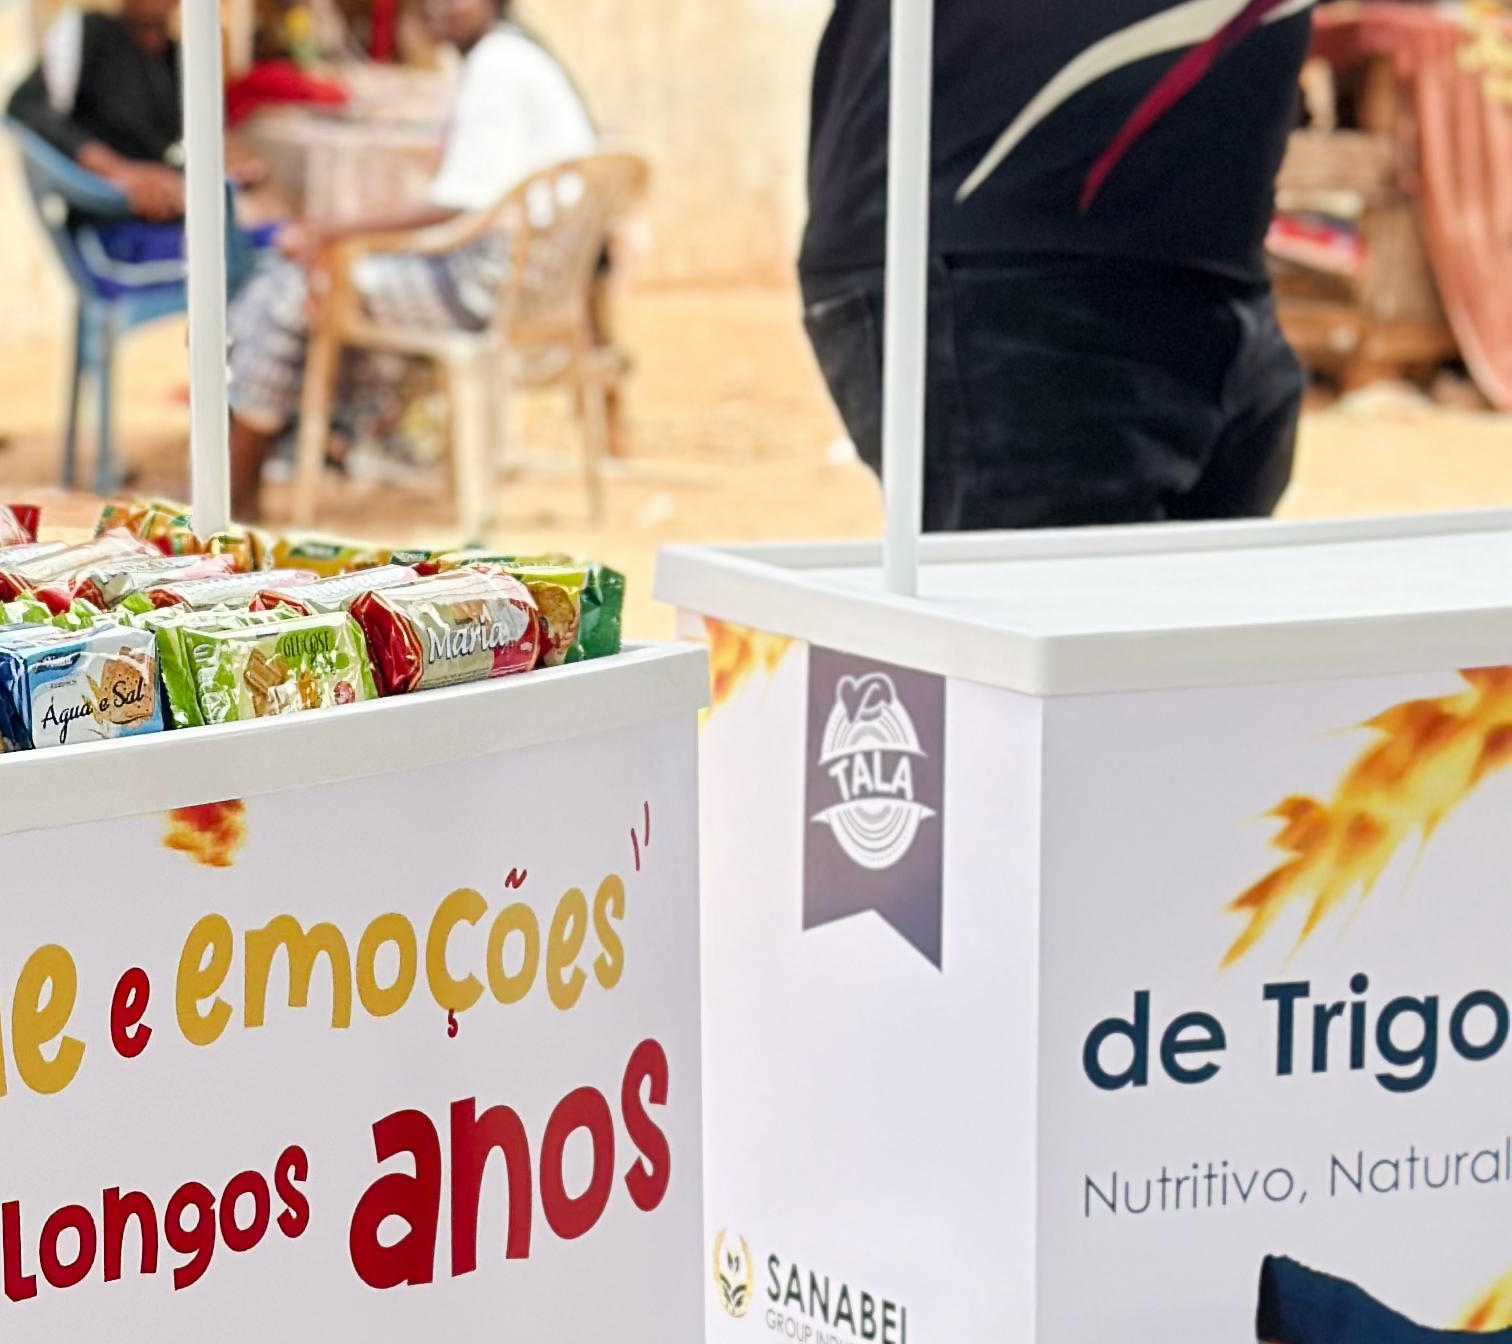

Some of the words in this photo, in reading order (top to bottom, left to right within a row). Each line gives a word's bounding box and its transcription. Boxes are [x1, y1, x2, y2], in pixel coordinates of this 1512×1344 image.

[427, 621, 505, 666] Maria
[41, 696, 94, 744] Água
[98, 698, 110, 713] e
[111, 677, 145, 708] Sal
[828, 750, 913, 801] TALA
[111, 967, 155, 1059] e
[1082, 990, 1227, 1091] de
[1263, 972, 1510, 1093] Trigo
[348, 1038, 671, 1290] anos
[1085, 1160, 1308, 1218] Nutritivo,
[766, 1309, 813, 1343] GROUP
